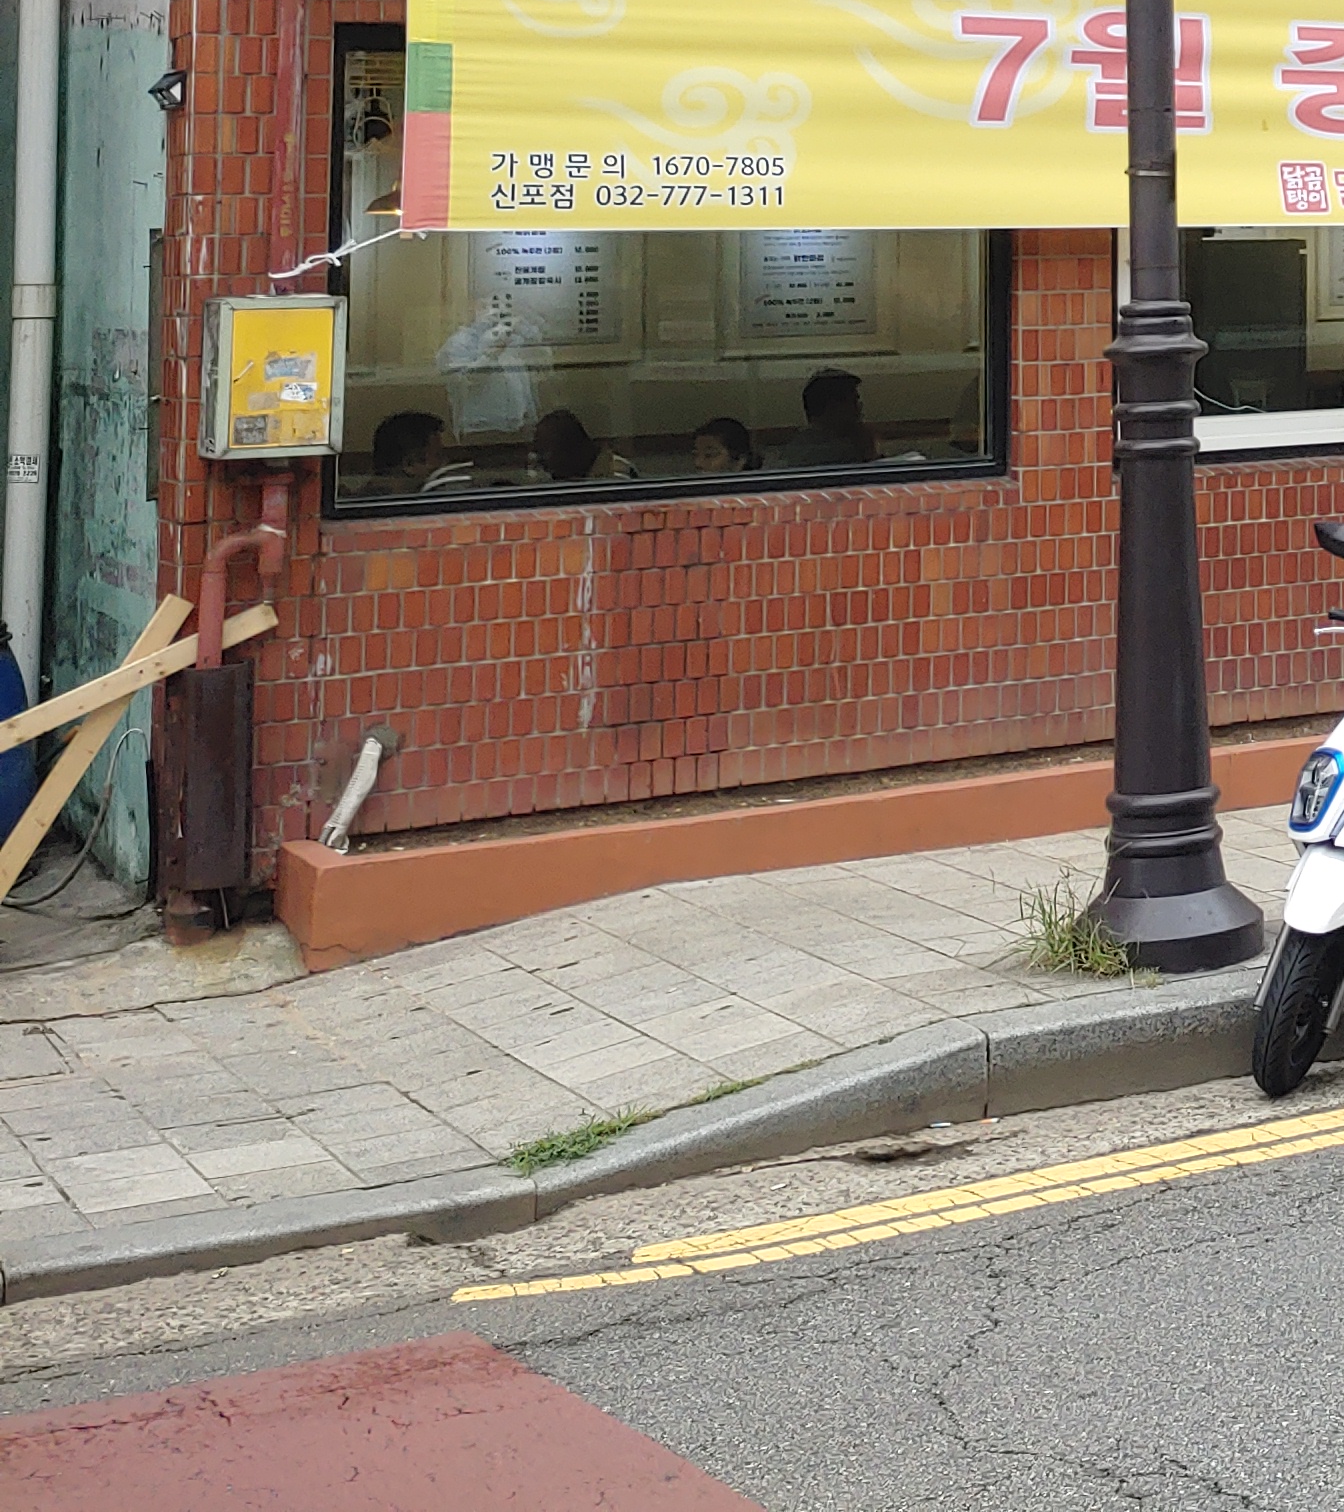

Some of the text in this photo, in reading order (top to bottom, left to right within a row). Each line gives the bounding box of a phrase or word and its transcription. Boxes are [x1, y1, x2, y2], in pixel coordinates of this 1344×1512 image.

[959, 11, 1207, 130] 7월
[651, 155, 785, 177] 1670-7805
[491, 182, 784, 210] 신포점 032-777-1311
